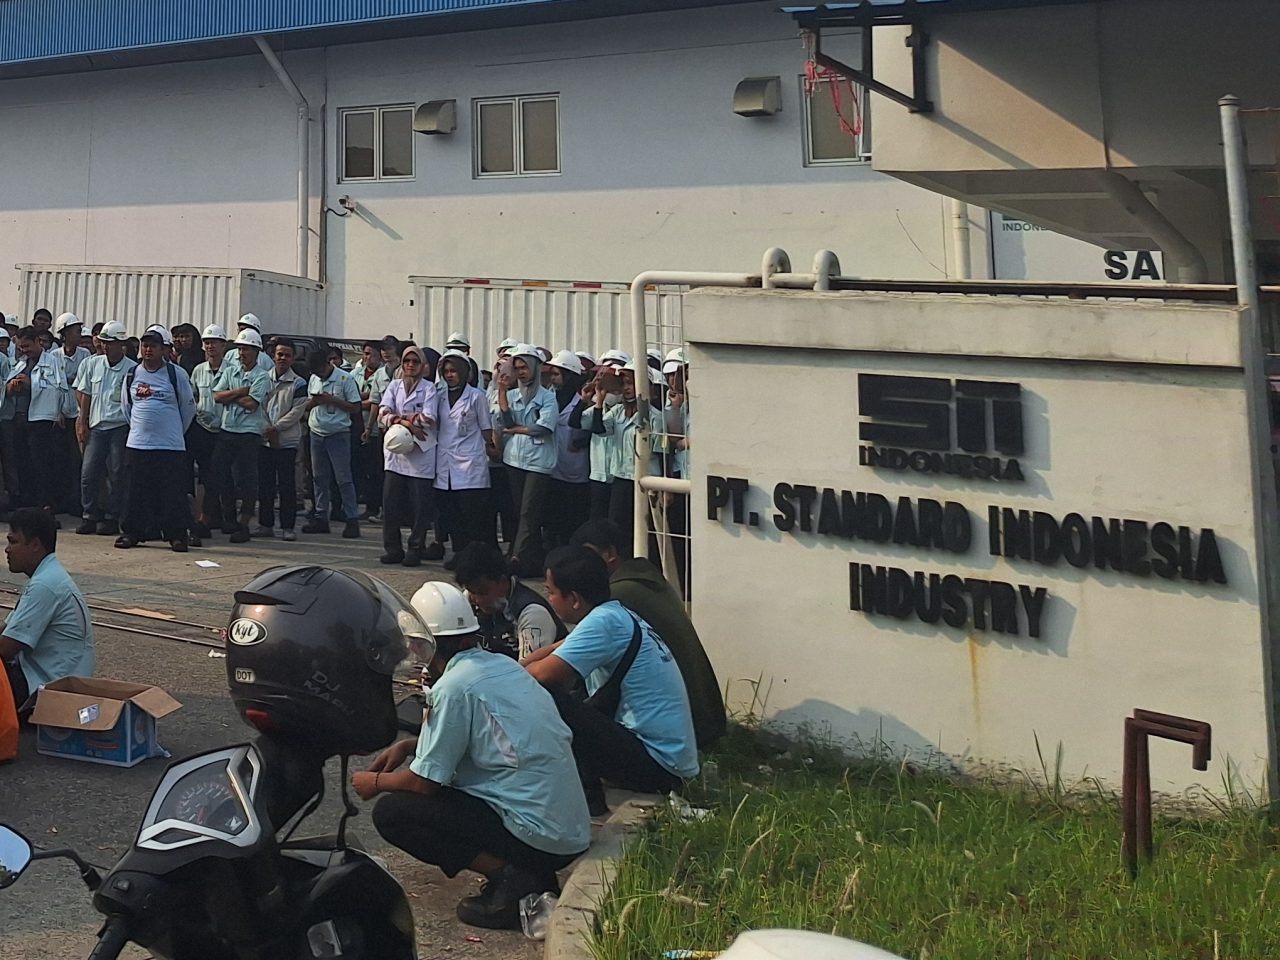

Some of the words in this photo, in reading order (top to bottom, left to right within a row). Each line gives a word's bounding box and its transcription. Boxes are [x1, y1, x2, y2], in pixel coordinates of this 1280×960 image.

[859, 445, 1025, 481] INDONESIA
[707, 475, 760, 526] PT.
[773, 482, 972, 553] STANDARD
[988, 505, 1227, 585] INDONESIA
[849, 562, 1048, 638] INDUSTRY
[236, 670, 252, 680] DOT
